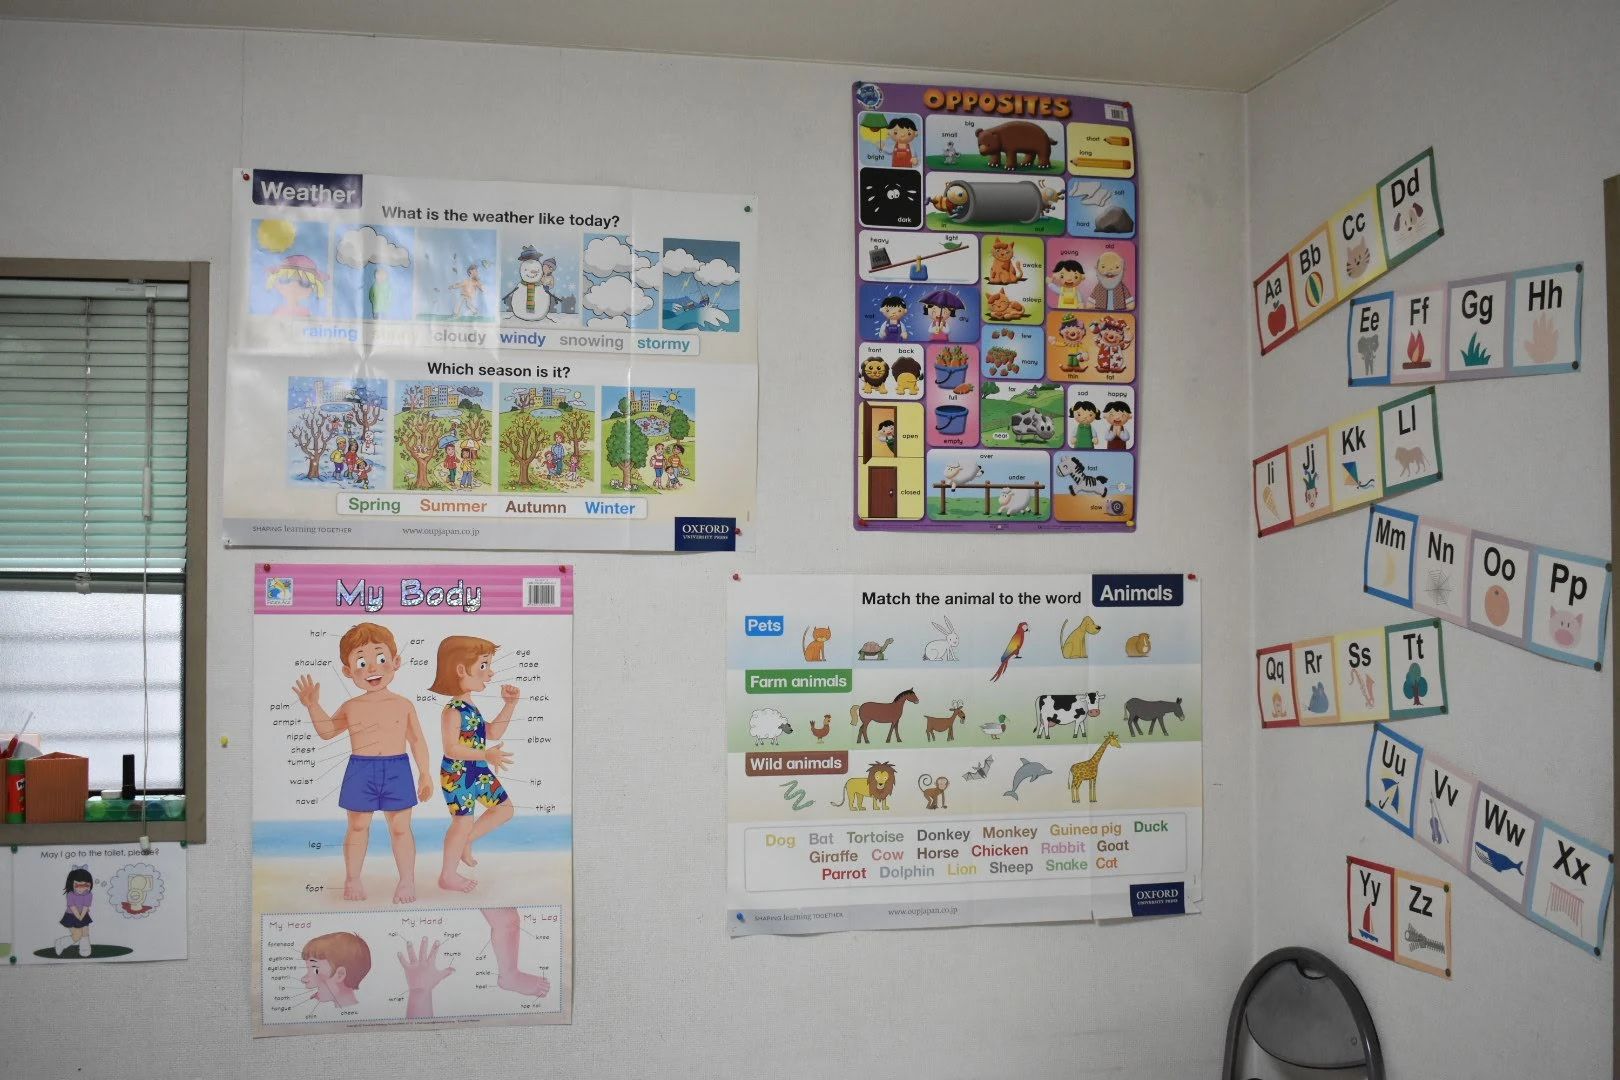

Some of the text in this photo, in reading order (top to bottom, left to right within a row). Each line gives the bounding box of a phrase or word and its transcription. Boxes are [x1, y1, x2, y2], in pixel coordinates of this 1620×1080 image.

[923, 88, 1072, 119] OPPOSITES
[964, 120, 975, 128] big
[867, 153, 885, 161] bright
[1080, 149, 1093, 157] long
[261, 180, 356, 204] Weather
[382, 205, 620, 230] What is the weather like today?
[945, 235, 959, 243] light
[1264, 168, 1420, 304] Aa Bb Cc Dd
[1060, 248, 1079, 257] young
[1360, 278, 1563, 332] Ee Ff Gg Hh
[303, 325, 358, 342] raining
[434, 329, 486, 345] cloudy
[500, 331, 547, 347] windy
[560, 334, 625, 350] snowing
[637, 337, 690, 353] stormy
[1021, 359, 1038, 367] many
[428, 362, 571, 379] Which season is it?
[1107, 391, 1127, 399] happy
[1267, 405, 1416, 485] Ii Jj Kk Ll
[349, 497, 636, 515] Spring Summer Autumn Winter
[284, 526, 317, 535] learning
[402, 527, 480, 536] www.oupjapan.co.jp
[682, 523, 729, 534] OXFORD
[1375, 517, 1588, 606] Mm Nn Oo Pp
[336, 578, 482, 613] My Body
[1100, 585, 1173, 601] Animals
[862, 592, 1081, 605] Match the animal to the word
[748, 619, 781, 632] Pets
[516, 649, 531, 657] eye
[410, 658, 428, 666] face
[1266, 633, 1424, 684] Qq Rr Ss Tt
[750, 675, 847, 688] Farm animals
[270, 702, 290, 712] palm
[272, 719, 301, 727] armpit
[286, 732, 312, 742] nipple
[291, 746, 315, 754] chest
[287, 759, 316, 768] tummy
[750, 757, 842, 770] Wild animals
[529, 779, 542, 787] hip
[295, 797, 318, 805] navel
[535, 804, 555, 813] thigh
[1382, 739, 1590, 886] Uu Vv Ww Xx
[765, 820, 1168, 848] Dog Bat Tortoise Donkey Monkey Guinea pig Duck
[308, 840, 321, 849] leg
[40, 850, 59, 860] May
[65, 852, 76, 860] go
[89, 848, 102, 857] the
[104, 848, 126, 858] toilet,
[809, 840, 1129, 864] Giraffe Cow Horse Chicken Rabbit Goat
[822, 857, 1118, 880] Parrot Dolphin Lion Sheep Snake Cat
[305, 884, 324, 893] foot
[1359, 869, 1433, 917] Yy Zz
[1136, 889, 1178, 900] OXFORD
[782, 912, 812, 921] learning
[888, 907, 958, 917] www.oupjapan.co.jp
[402, 918, 415, 928] My
[524, 914, 558, 923] My Leg
[269, 921, 312, 931] My Head
